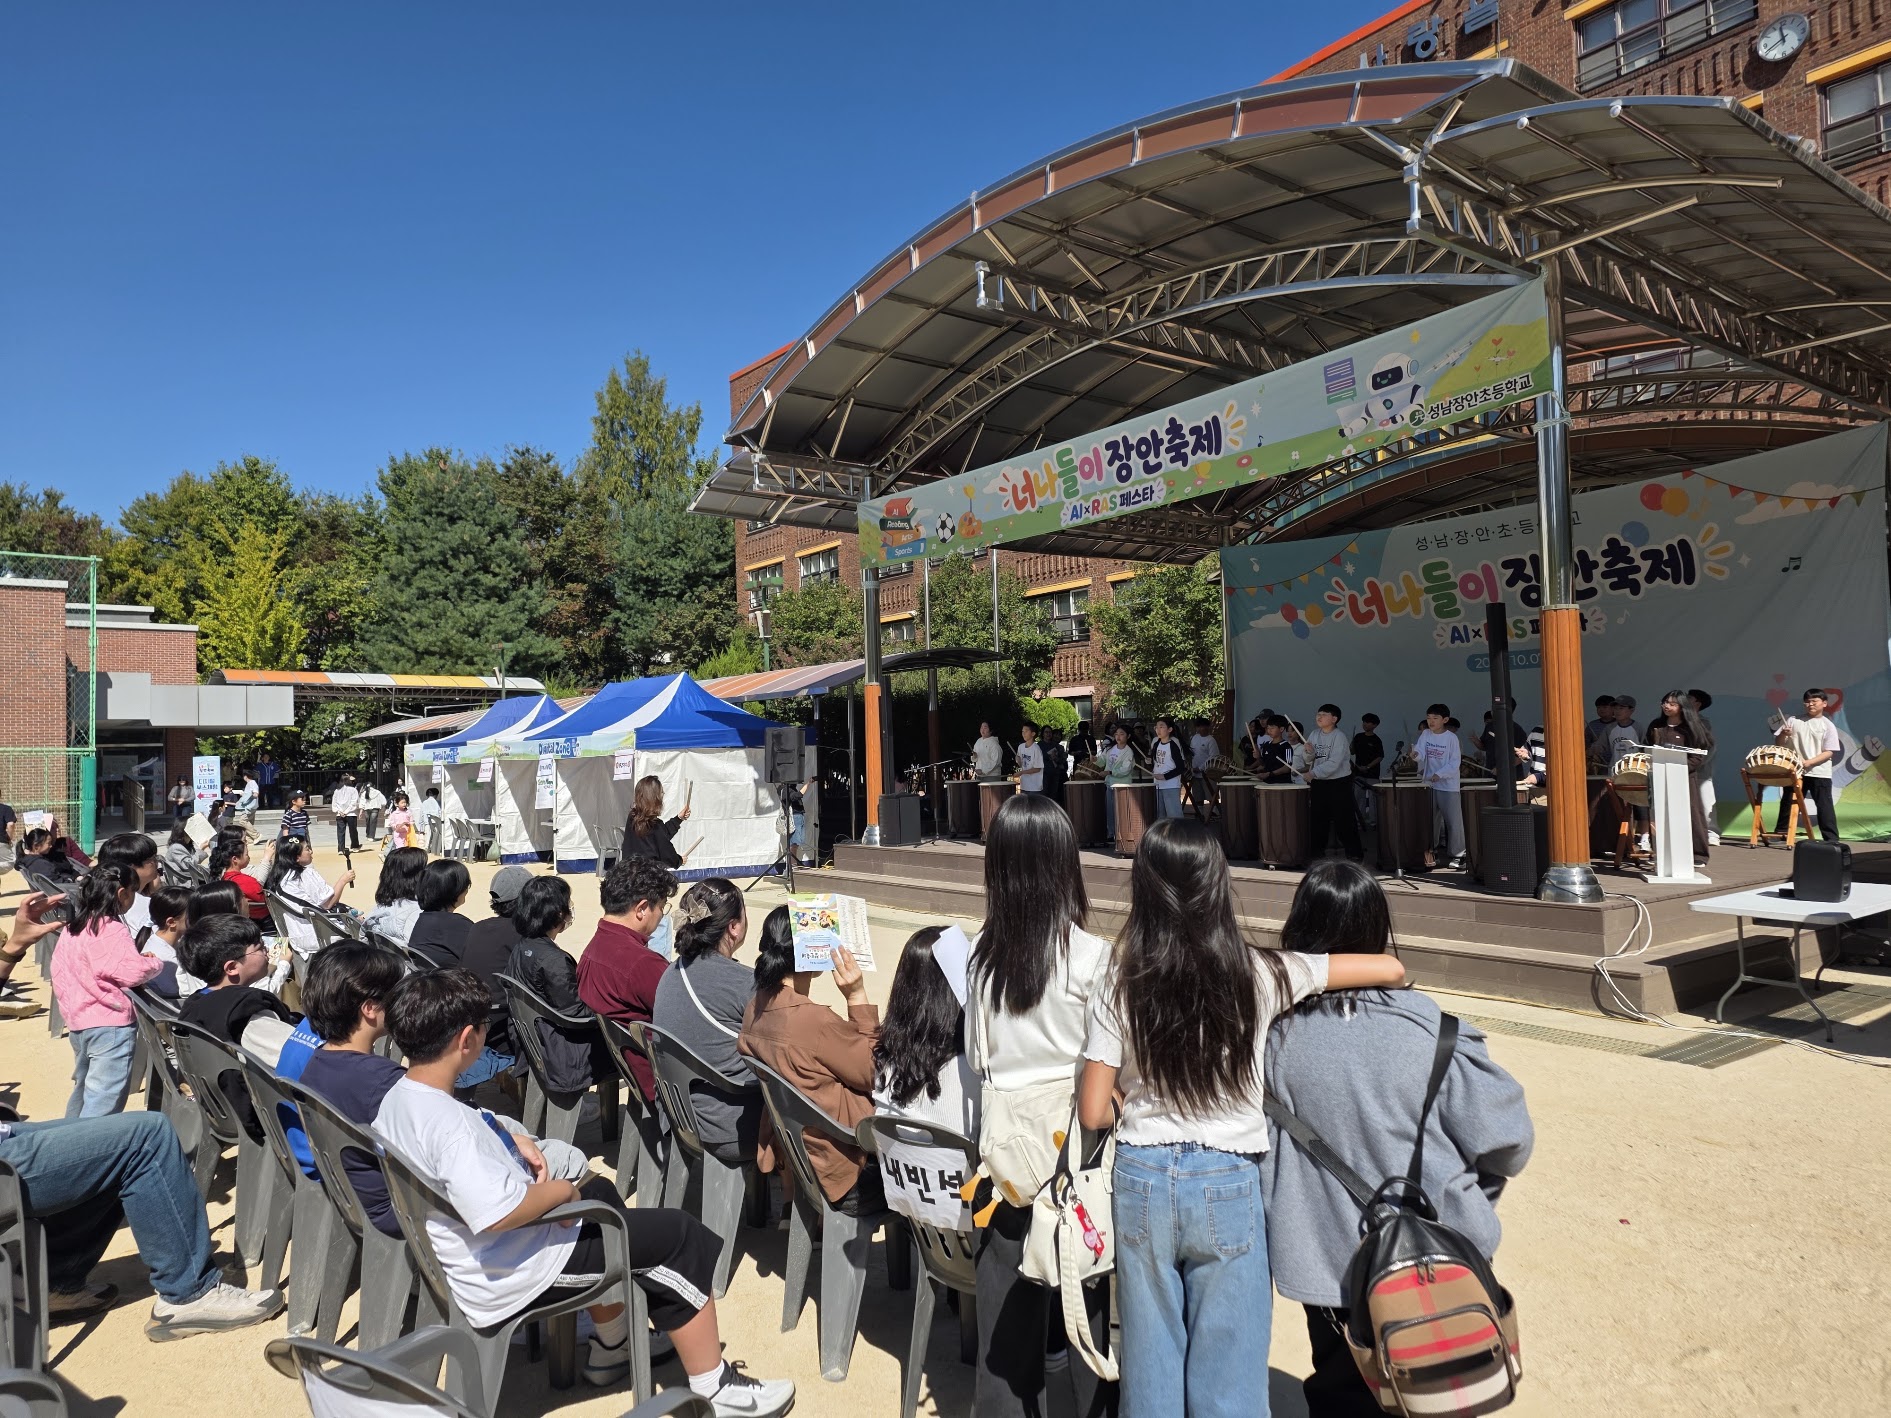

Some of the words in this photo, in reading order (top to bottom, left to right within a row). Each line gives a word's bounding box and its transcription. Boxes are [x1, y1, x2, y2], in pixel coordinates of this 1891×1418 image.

[1428, 374, 1532, 420] 성남장안초등학교
[1011, 446, 1103, 511] 너나들이
[1105, 416, 1222, 483] 장안축제
[1119, 484, 1154, 507] 페스타
[901, 533, 914, 541] Arts
[894, 547, 913, 556] Sports
[1348, 560, 1500, 625] 너나들이
[555, 741, 571, 756] Zone
